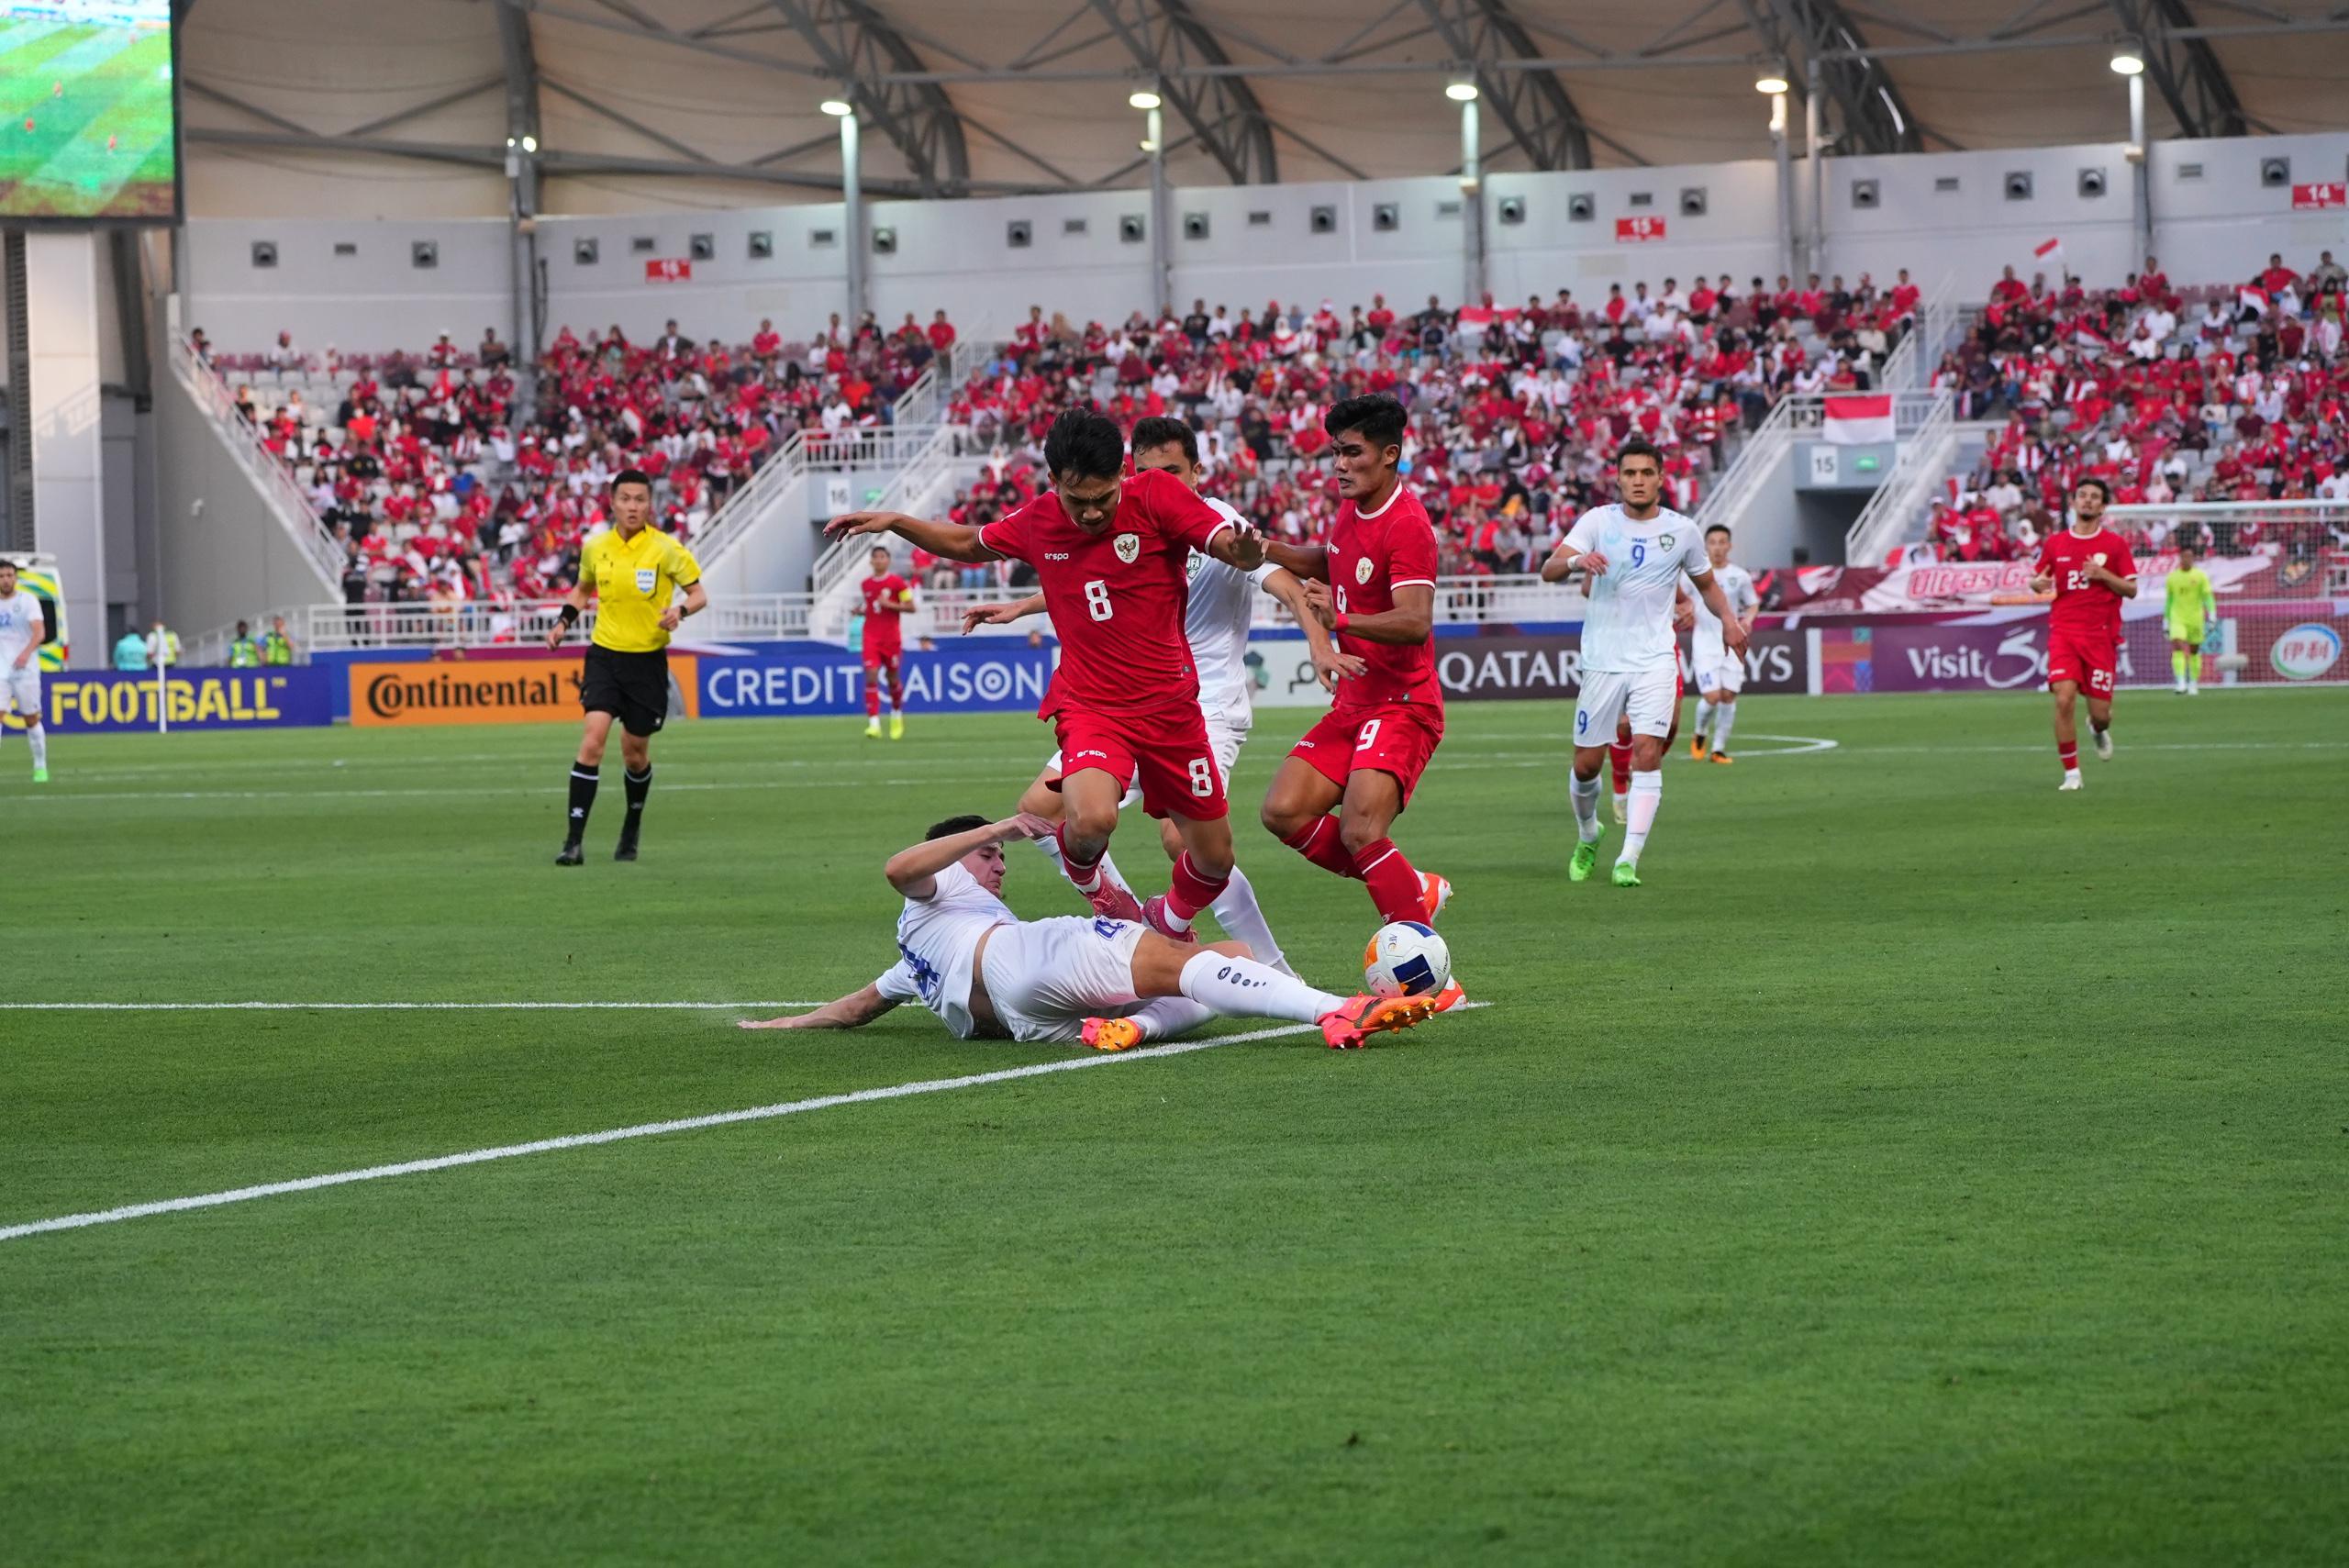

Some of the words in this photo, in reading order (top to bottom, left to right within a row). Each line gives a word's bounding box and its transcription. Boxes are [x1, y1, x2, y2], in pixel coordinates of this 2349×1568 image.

[2309, 184, 2331, 200] 14
[1816, 456, 1834, 473] 15
[1632, 544, 1645, 569] 9
[2067, 570, 2089, 590] 23
[1084, 579, 1113, 622] 8
[1438, 650, 1582, 694] QATAR
[1907, 645, 1984, 679] Visit
[368, 673, 559, 718] Continental
[707, 665, 863, 707] CREDIT
[2091, 669, 2112, 692] 23
[50, 677, 280, 725] FOOTBALL
[1355, 718, 1383, 751] 9
[1578, 710, 1587, 735] 9
[1188, 757, 1214, 797] 8
